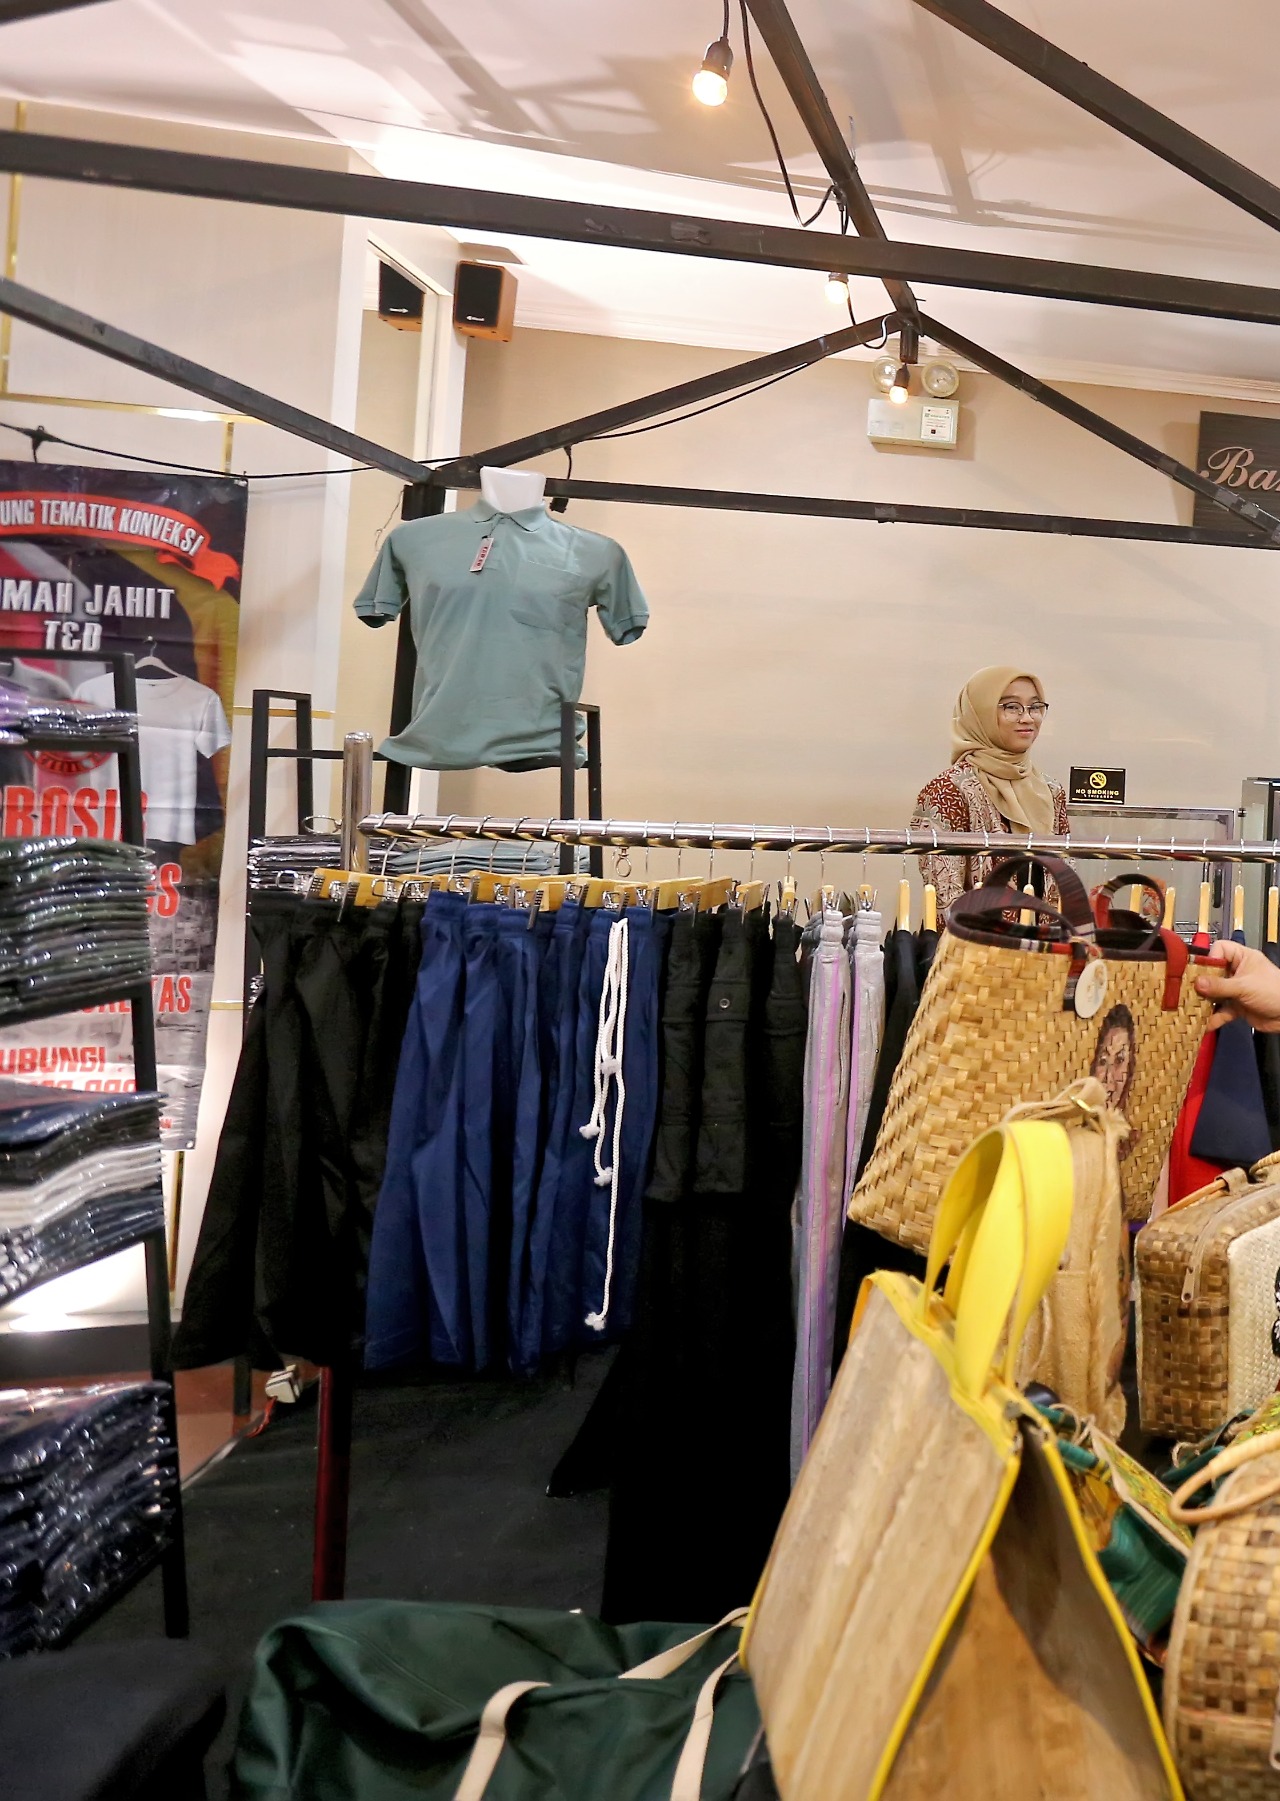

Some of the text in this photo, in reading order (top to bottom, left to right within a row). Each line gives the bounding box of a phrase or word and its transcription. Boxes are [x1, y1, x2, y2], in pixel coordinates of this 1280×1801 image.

[40, 499, 116, 532] TEMATIK
[118, 508, 205, 557] KONVEKSI
[0, 578, 175, 619] MAH JAHIT
[43, 620, 103, 651] T&D
[0, 785, 148, 842] ROSI
